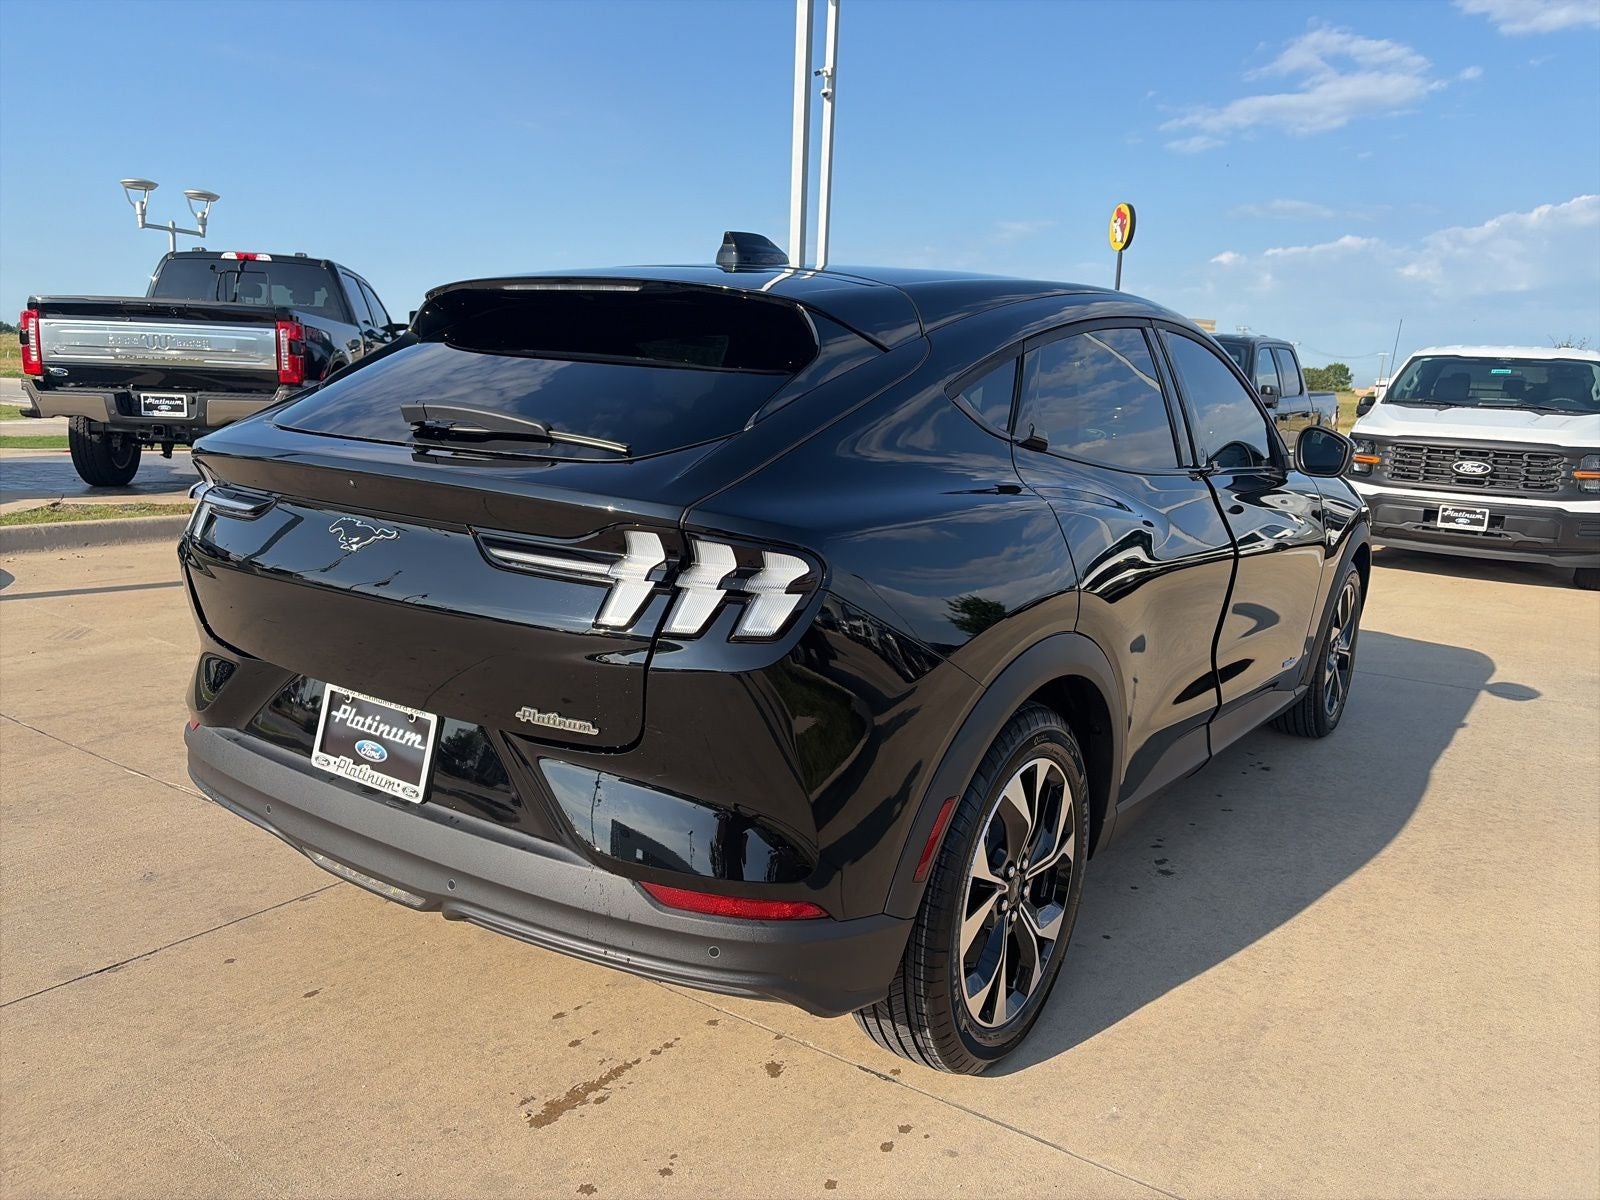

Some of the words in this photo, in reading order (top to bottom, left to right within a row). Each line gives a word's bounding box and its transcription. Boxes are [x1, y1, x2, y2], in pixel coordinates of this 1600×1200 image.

[1442, 510, 1485, 520] Platinum
[331, 704, 426, 750] Platinum
[515, 706, 600, 736] Platinum
[360, 742, 382, 760] Ford
[336, 758, 399, 793] Platinum
